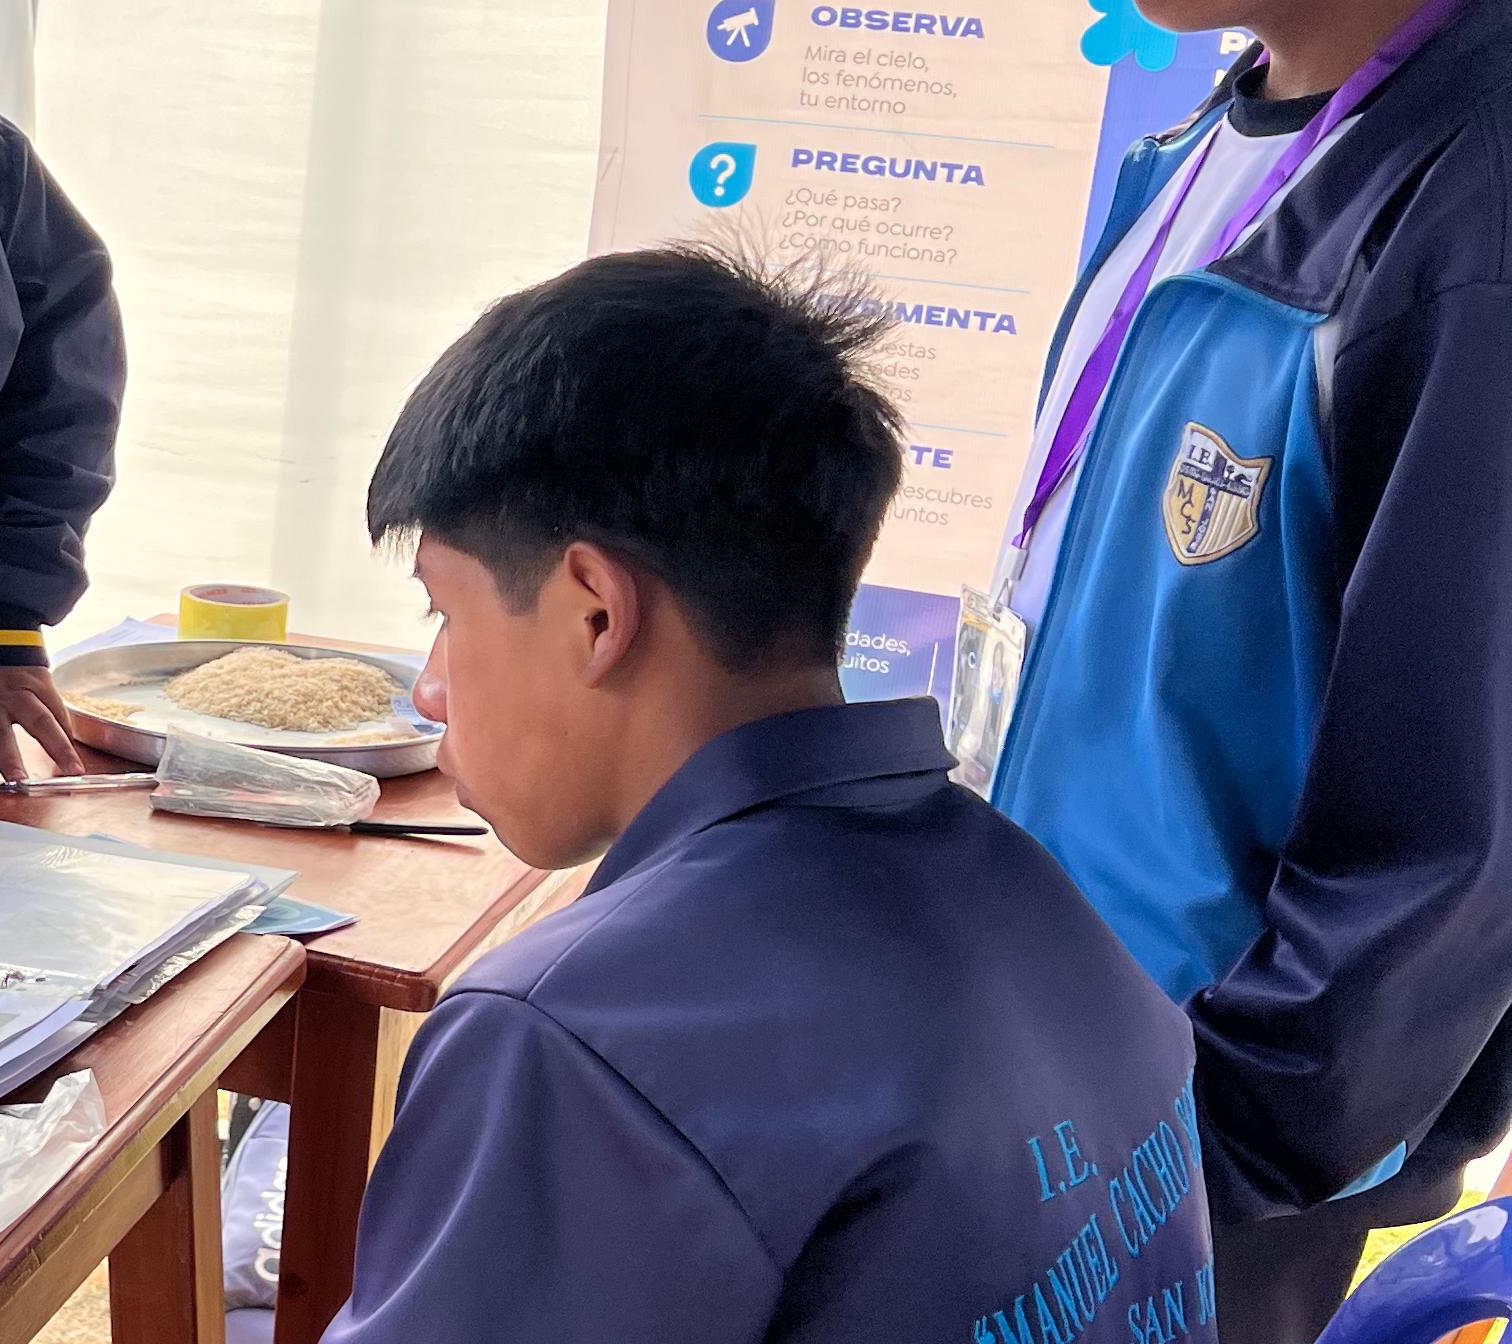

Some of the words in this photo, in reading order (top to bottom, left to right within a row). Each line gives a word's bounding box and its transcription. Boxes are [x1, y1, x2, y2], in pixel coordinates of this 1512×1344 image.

[810, 4, 985, 40] OBSERVA
[804, 45, 847, 64] Mira
[853, 47, 872, 66] el
[876, 49, 929, 72] cielo,
[801, 66, 830, 87] los
[835, 68, 958, 99] fenómenos,
[799, 90, 819, 108] tu
[824, 94, 907, 115] entorno
[791, 147, 986, 186] PREGUNTA
[785, 187, 838, 209] ¿Qué
[843, 194, 902, 215] pasa?
[782, 210, 827, 229] ¿Por
[831, 214, 871, 236] qué
[875, 219, 955, 242] ocurre?
[857, 236, 958, 265] funciona?
[900, 485, 994, 509] escubres
[1026, 1119, 1098, 1202] I.E.
[1108, 1120, 1191, 1257] CACHO
